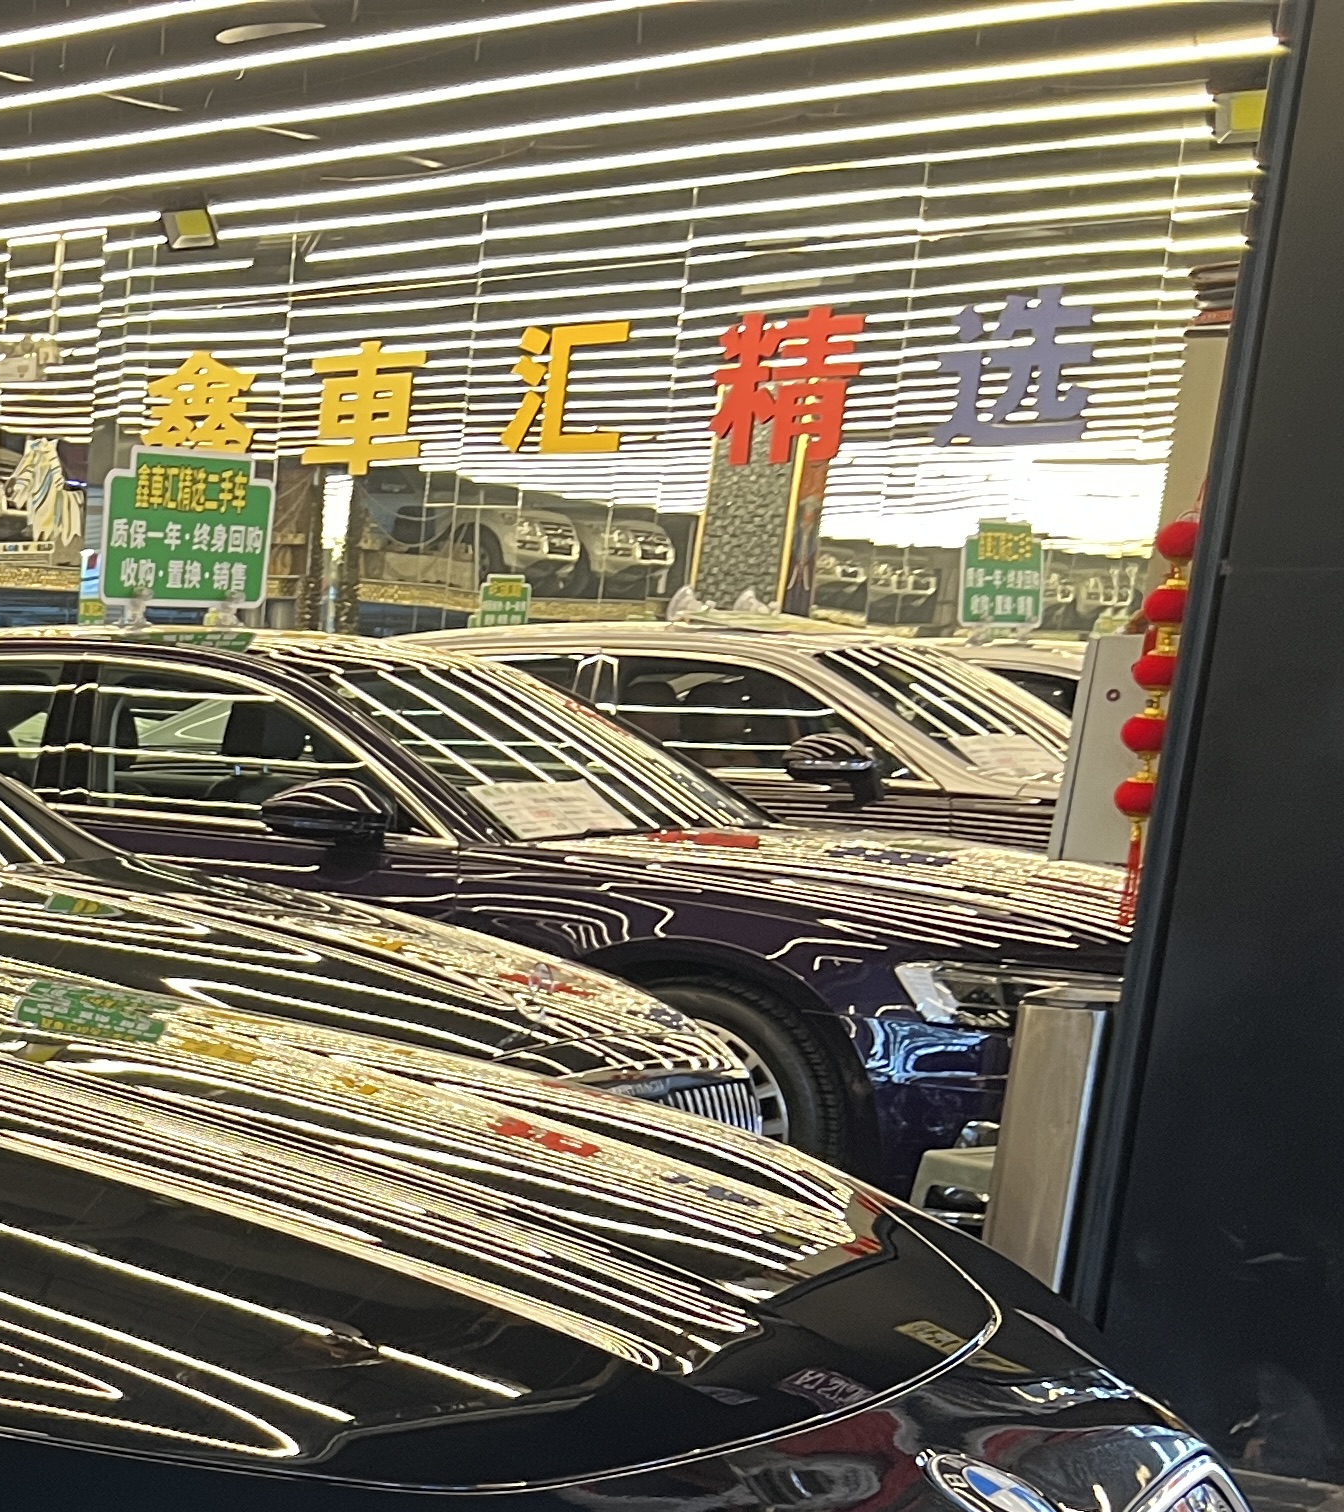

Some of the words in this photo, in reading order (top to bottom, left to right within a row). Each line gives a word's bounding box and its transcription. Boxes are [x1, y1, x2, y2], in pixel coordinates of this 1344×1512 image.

[139, 285, 1095, 476] 鑫車汇精选
[135, 463, 249, 514] 鑫車汇精选二手车
[110, 517, 264, 555] 质保一年·终身回购
[120, 557, 248, 592] 收购·置换·销售
